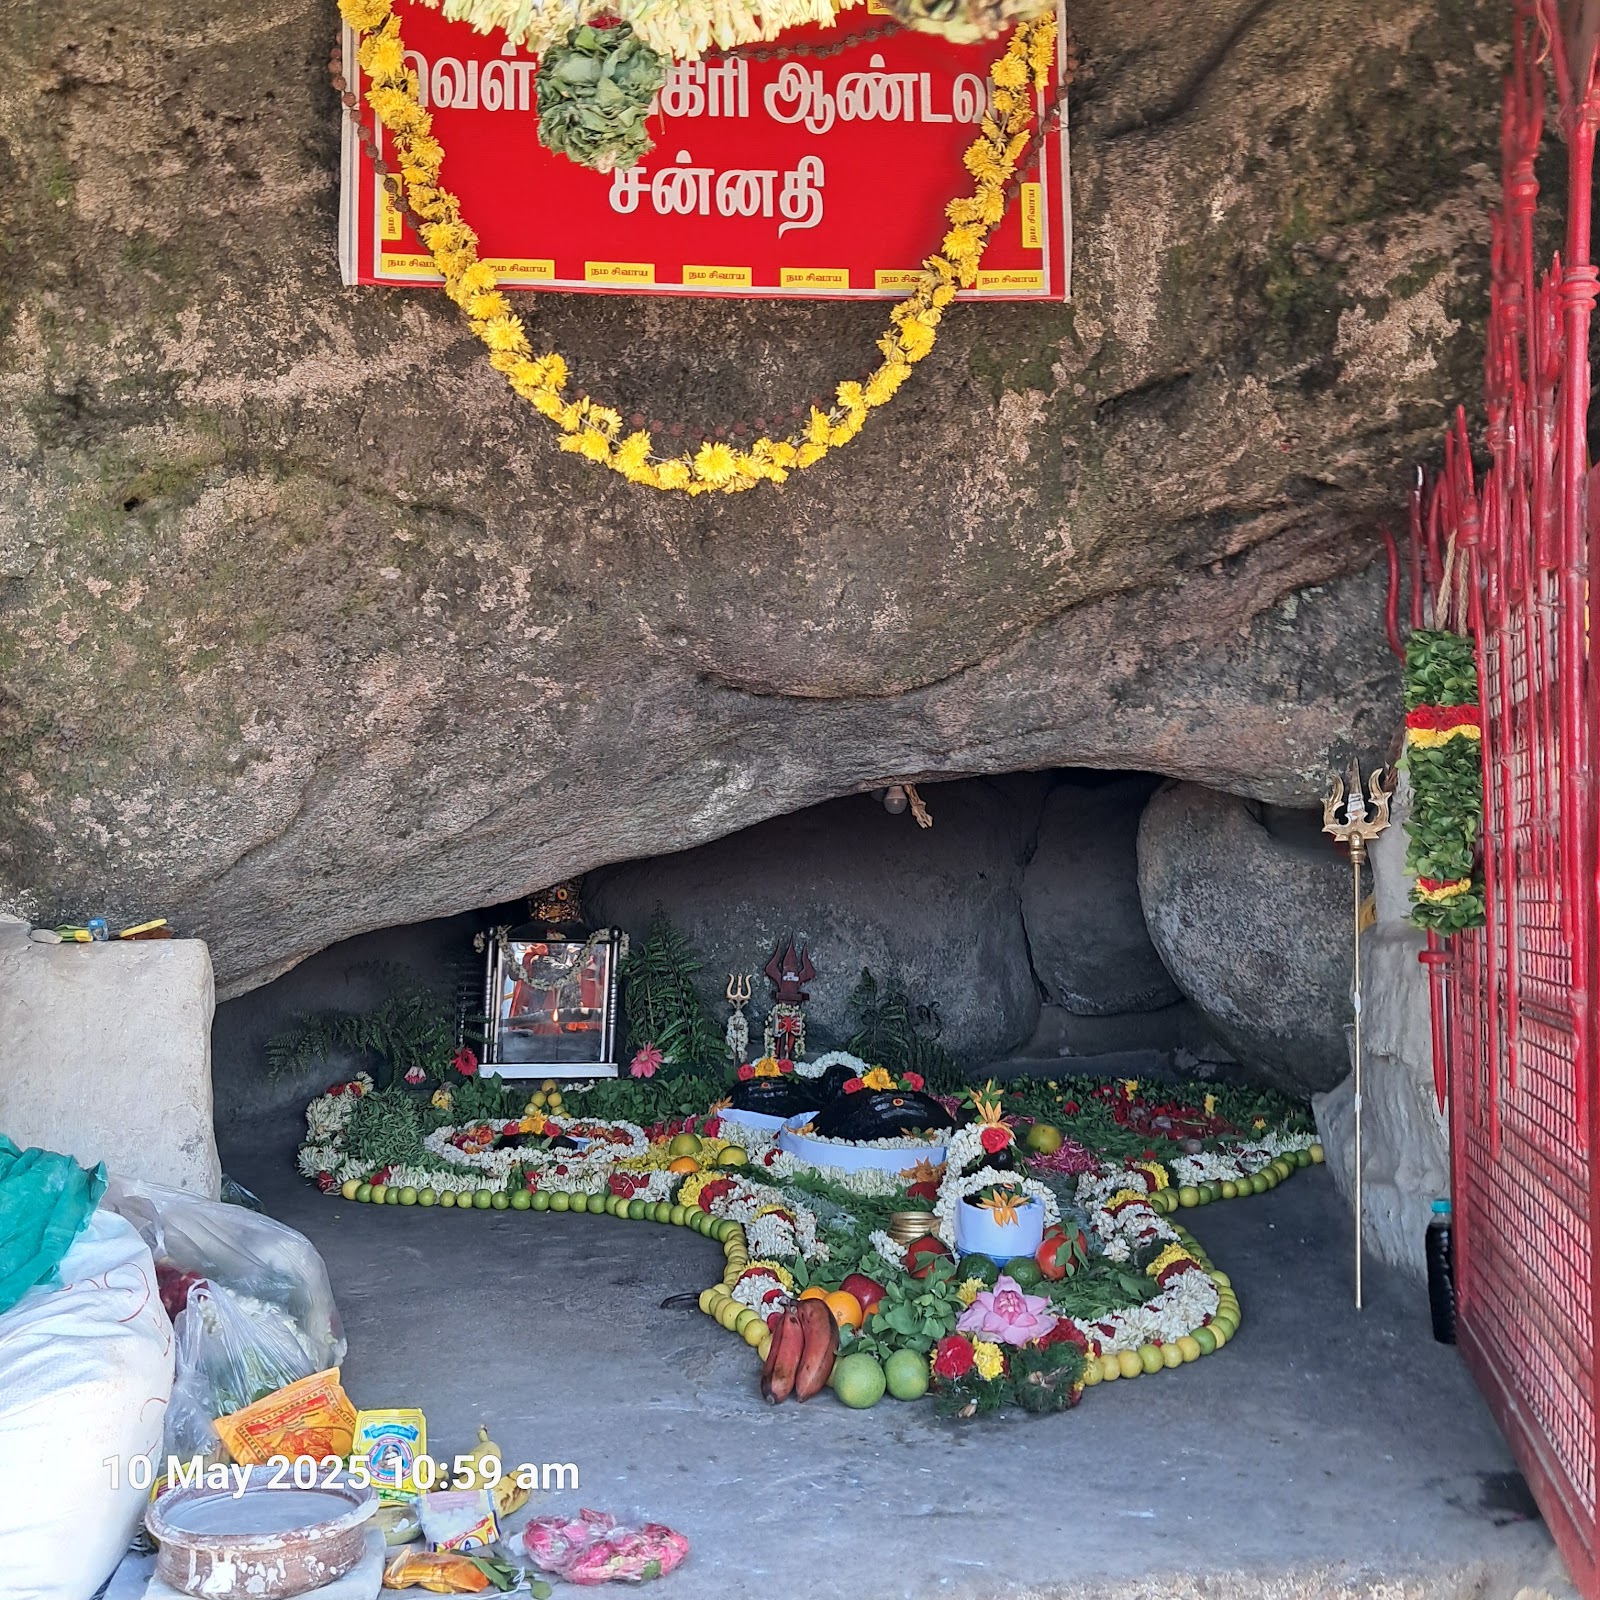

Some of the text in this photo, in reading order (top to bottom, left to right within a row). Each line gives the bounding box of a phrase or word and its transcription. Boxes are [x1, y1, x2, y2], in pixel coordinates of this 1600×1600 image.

[764, 54, 998, 134] ஆண்டவ
[609, 150, 825, 239] சன்னதி
[387, 259, 406, 267] நம
[509, 263, 547, 272] சிவாய
[591, 267, 648, 276] நம சிவாய
[689, 270, 745, 280] நம சிவாய
[786, 273, 842, 282] நம சிவாய
[881, 276, 899, 284] நம
[982, 275, 1038, 285] நம சிவாய
